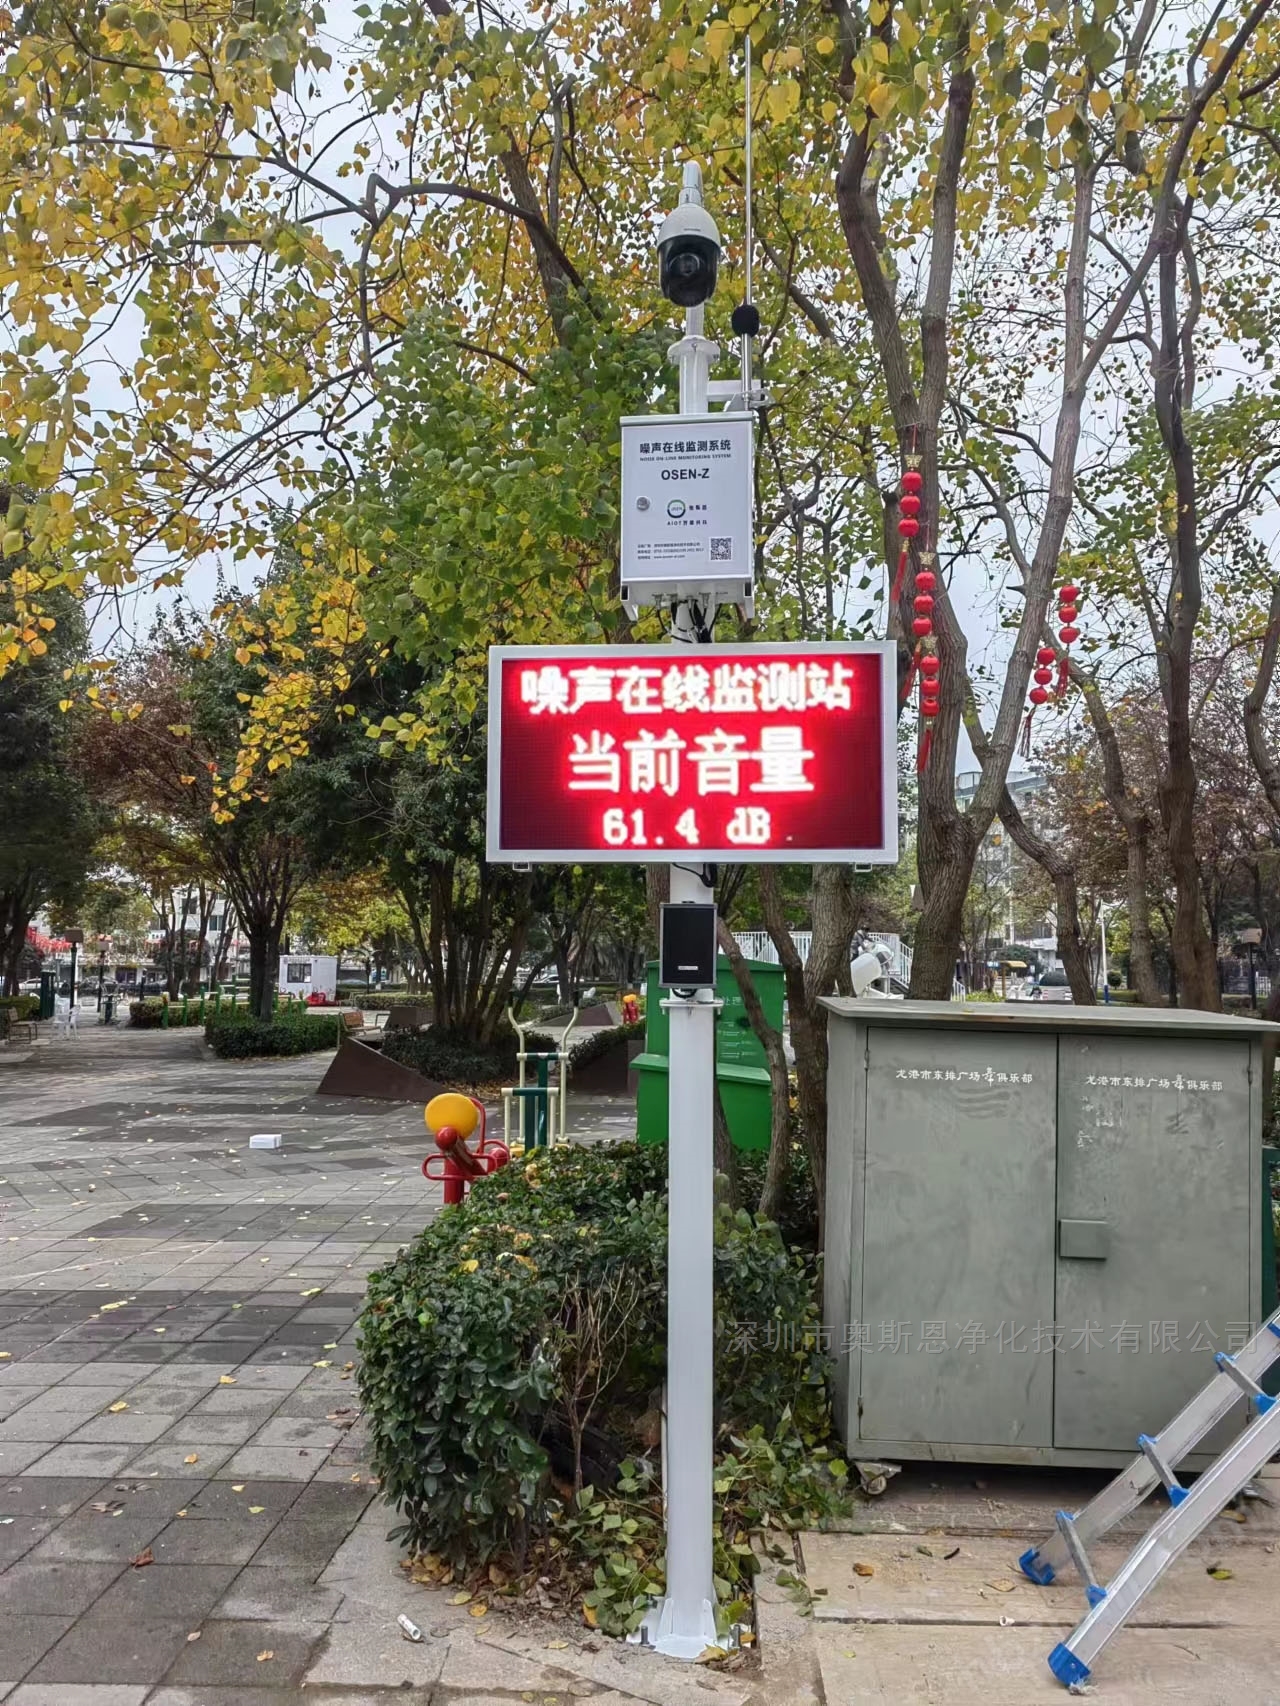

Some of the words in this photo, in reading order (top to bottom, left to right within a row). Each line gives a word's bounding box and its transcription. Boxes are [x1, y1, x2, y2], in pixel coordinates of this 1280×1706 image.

[640, 439, 731, 454] 噪声在线监测系统
[661, 468, 710, 480] OSEN-Z
[520, 661, 854, 715] 噪声在线监测站
[567, 724, 816, 797] 当前音量
[601, 806, 701, 846] 61.4
[726, 805, 771, 846] dB
